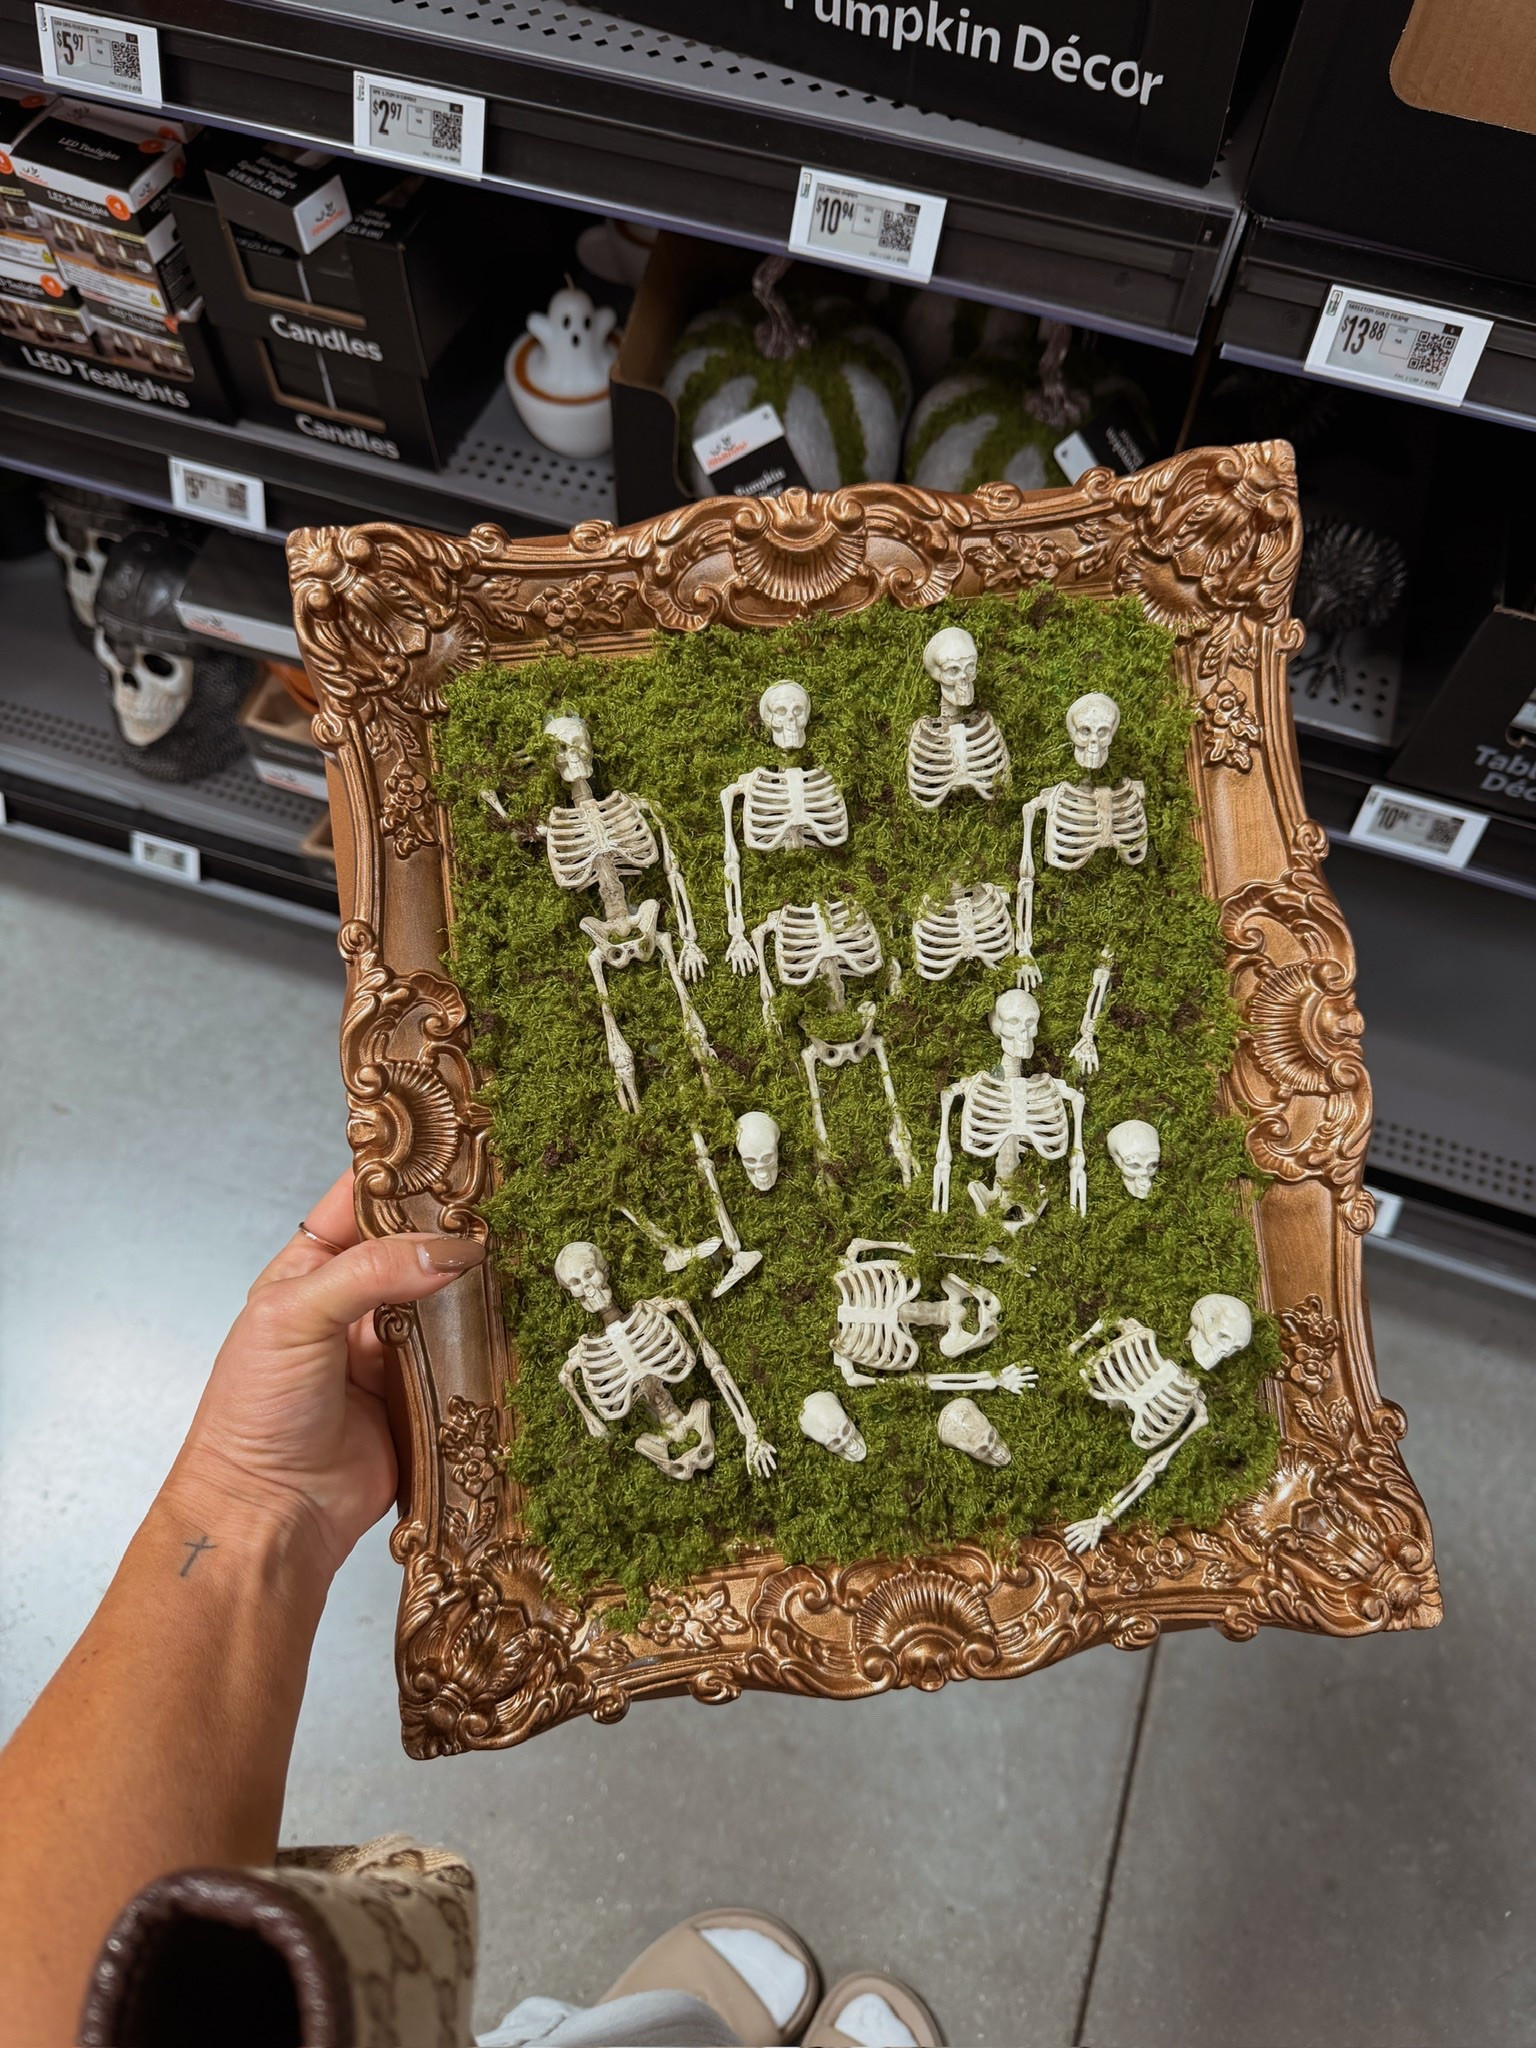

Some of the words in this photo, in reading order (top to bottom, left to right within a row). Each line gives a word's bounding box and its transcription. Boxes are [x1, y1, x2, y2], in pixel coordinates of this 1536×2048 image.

[784, 0, 1000, 63] umpkin
[1013, 24, 1163, 105] Décor
[58, 137, 79, 149] LED
[79, 143, 121, 161] Tealights
[68, 197, 109, 217] Tealights
[269, 313, 384, 362] Candles
[20, 345, 72, 375] LED
[71, 359, 190, 408] Tealights
[295, 413, 400, 460] Candles
